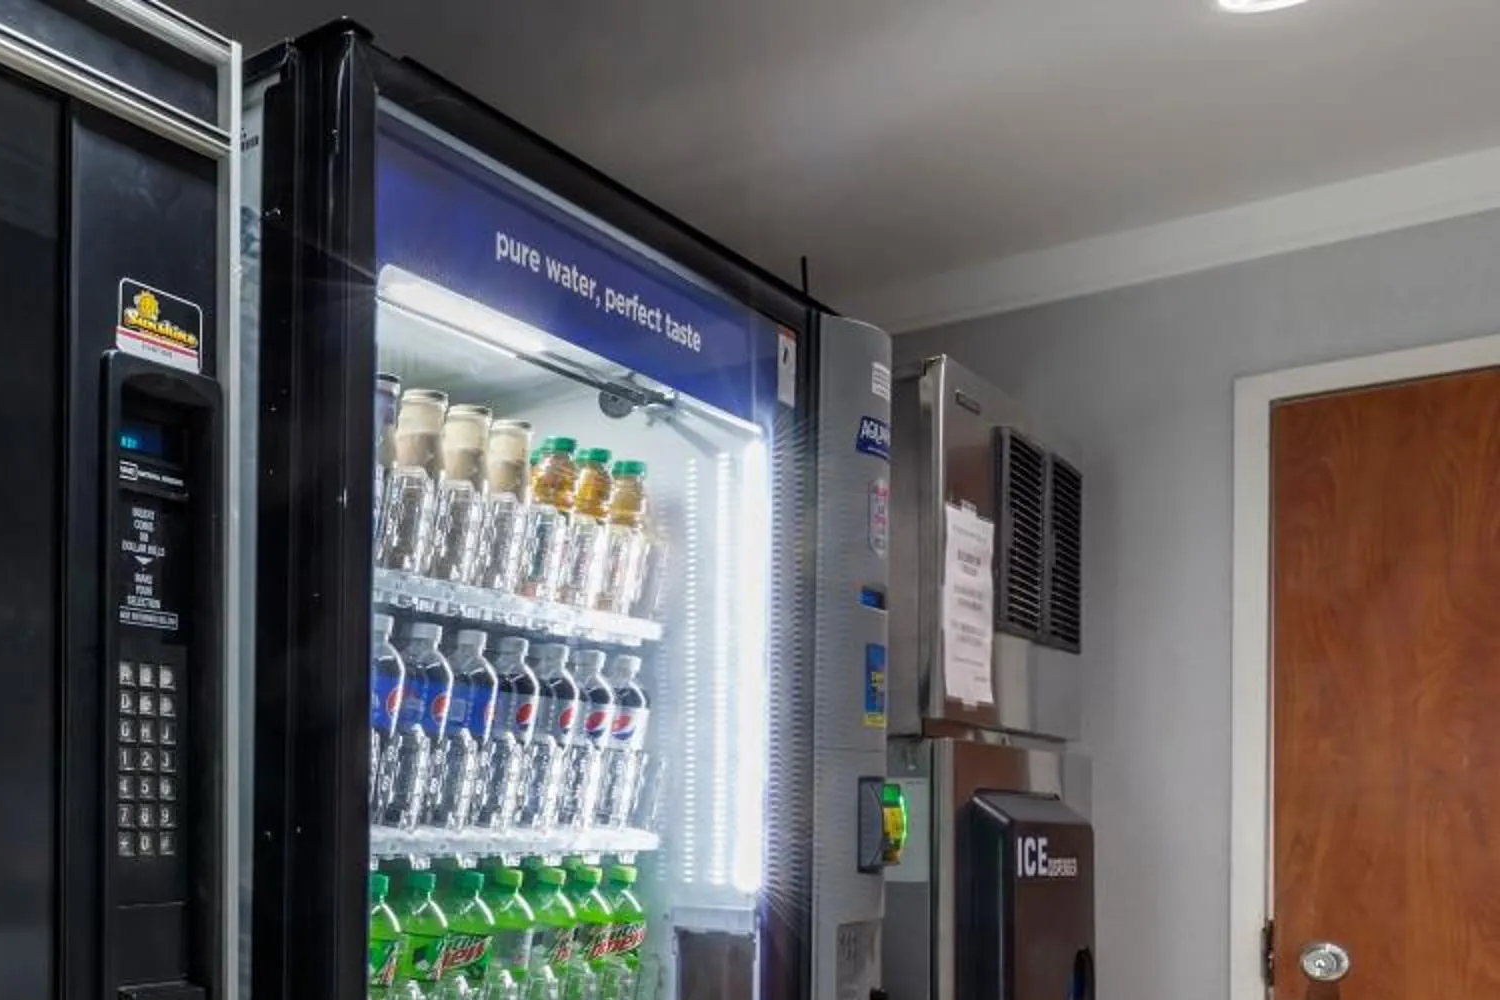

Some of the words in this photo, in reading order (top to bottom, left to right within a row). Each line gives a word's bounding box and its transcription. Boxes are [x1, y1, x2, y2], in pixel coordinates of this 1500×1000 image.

[495, 230, 541, 274] pure
[546, 256, 602, 308] water,
[604, 286, 663, 337] perfect
[664, 322, 702, 354] taste
[1017, 836, 1049, 877] ICE
